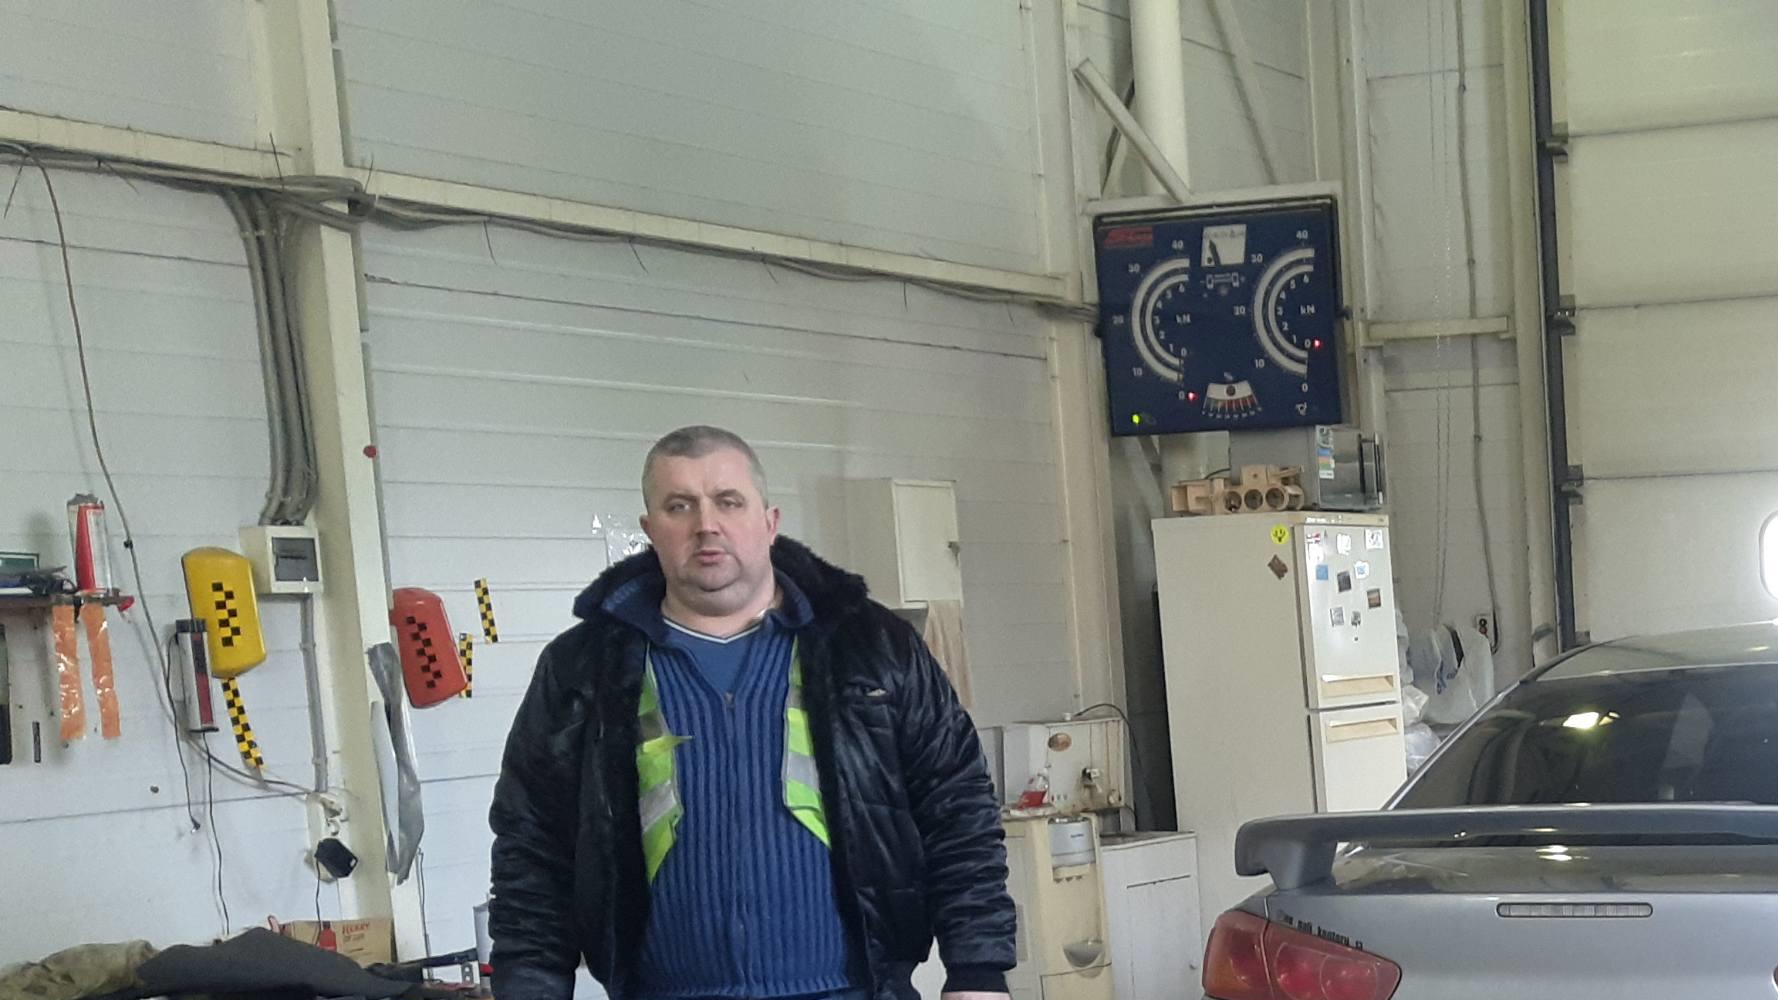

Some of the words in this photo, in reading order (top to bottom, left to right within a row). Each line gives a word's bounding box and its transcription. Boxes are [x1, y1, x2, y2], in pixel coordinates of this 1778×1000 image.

[1296, 229, 1309, 239] 40
[1304, 338, 1311, 348] 0
[1181, 347, 1188, 357] 0
[1254, 358, 1265, 368] 10
[1133, 367, 1143, 377] 10
[1302, 382, 1309, 393] 0
[1179, 390, 1186, 400] 0
